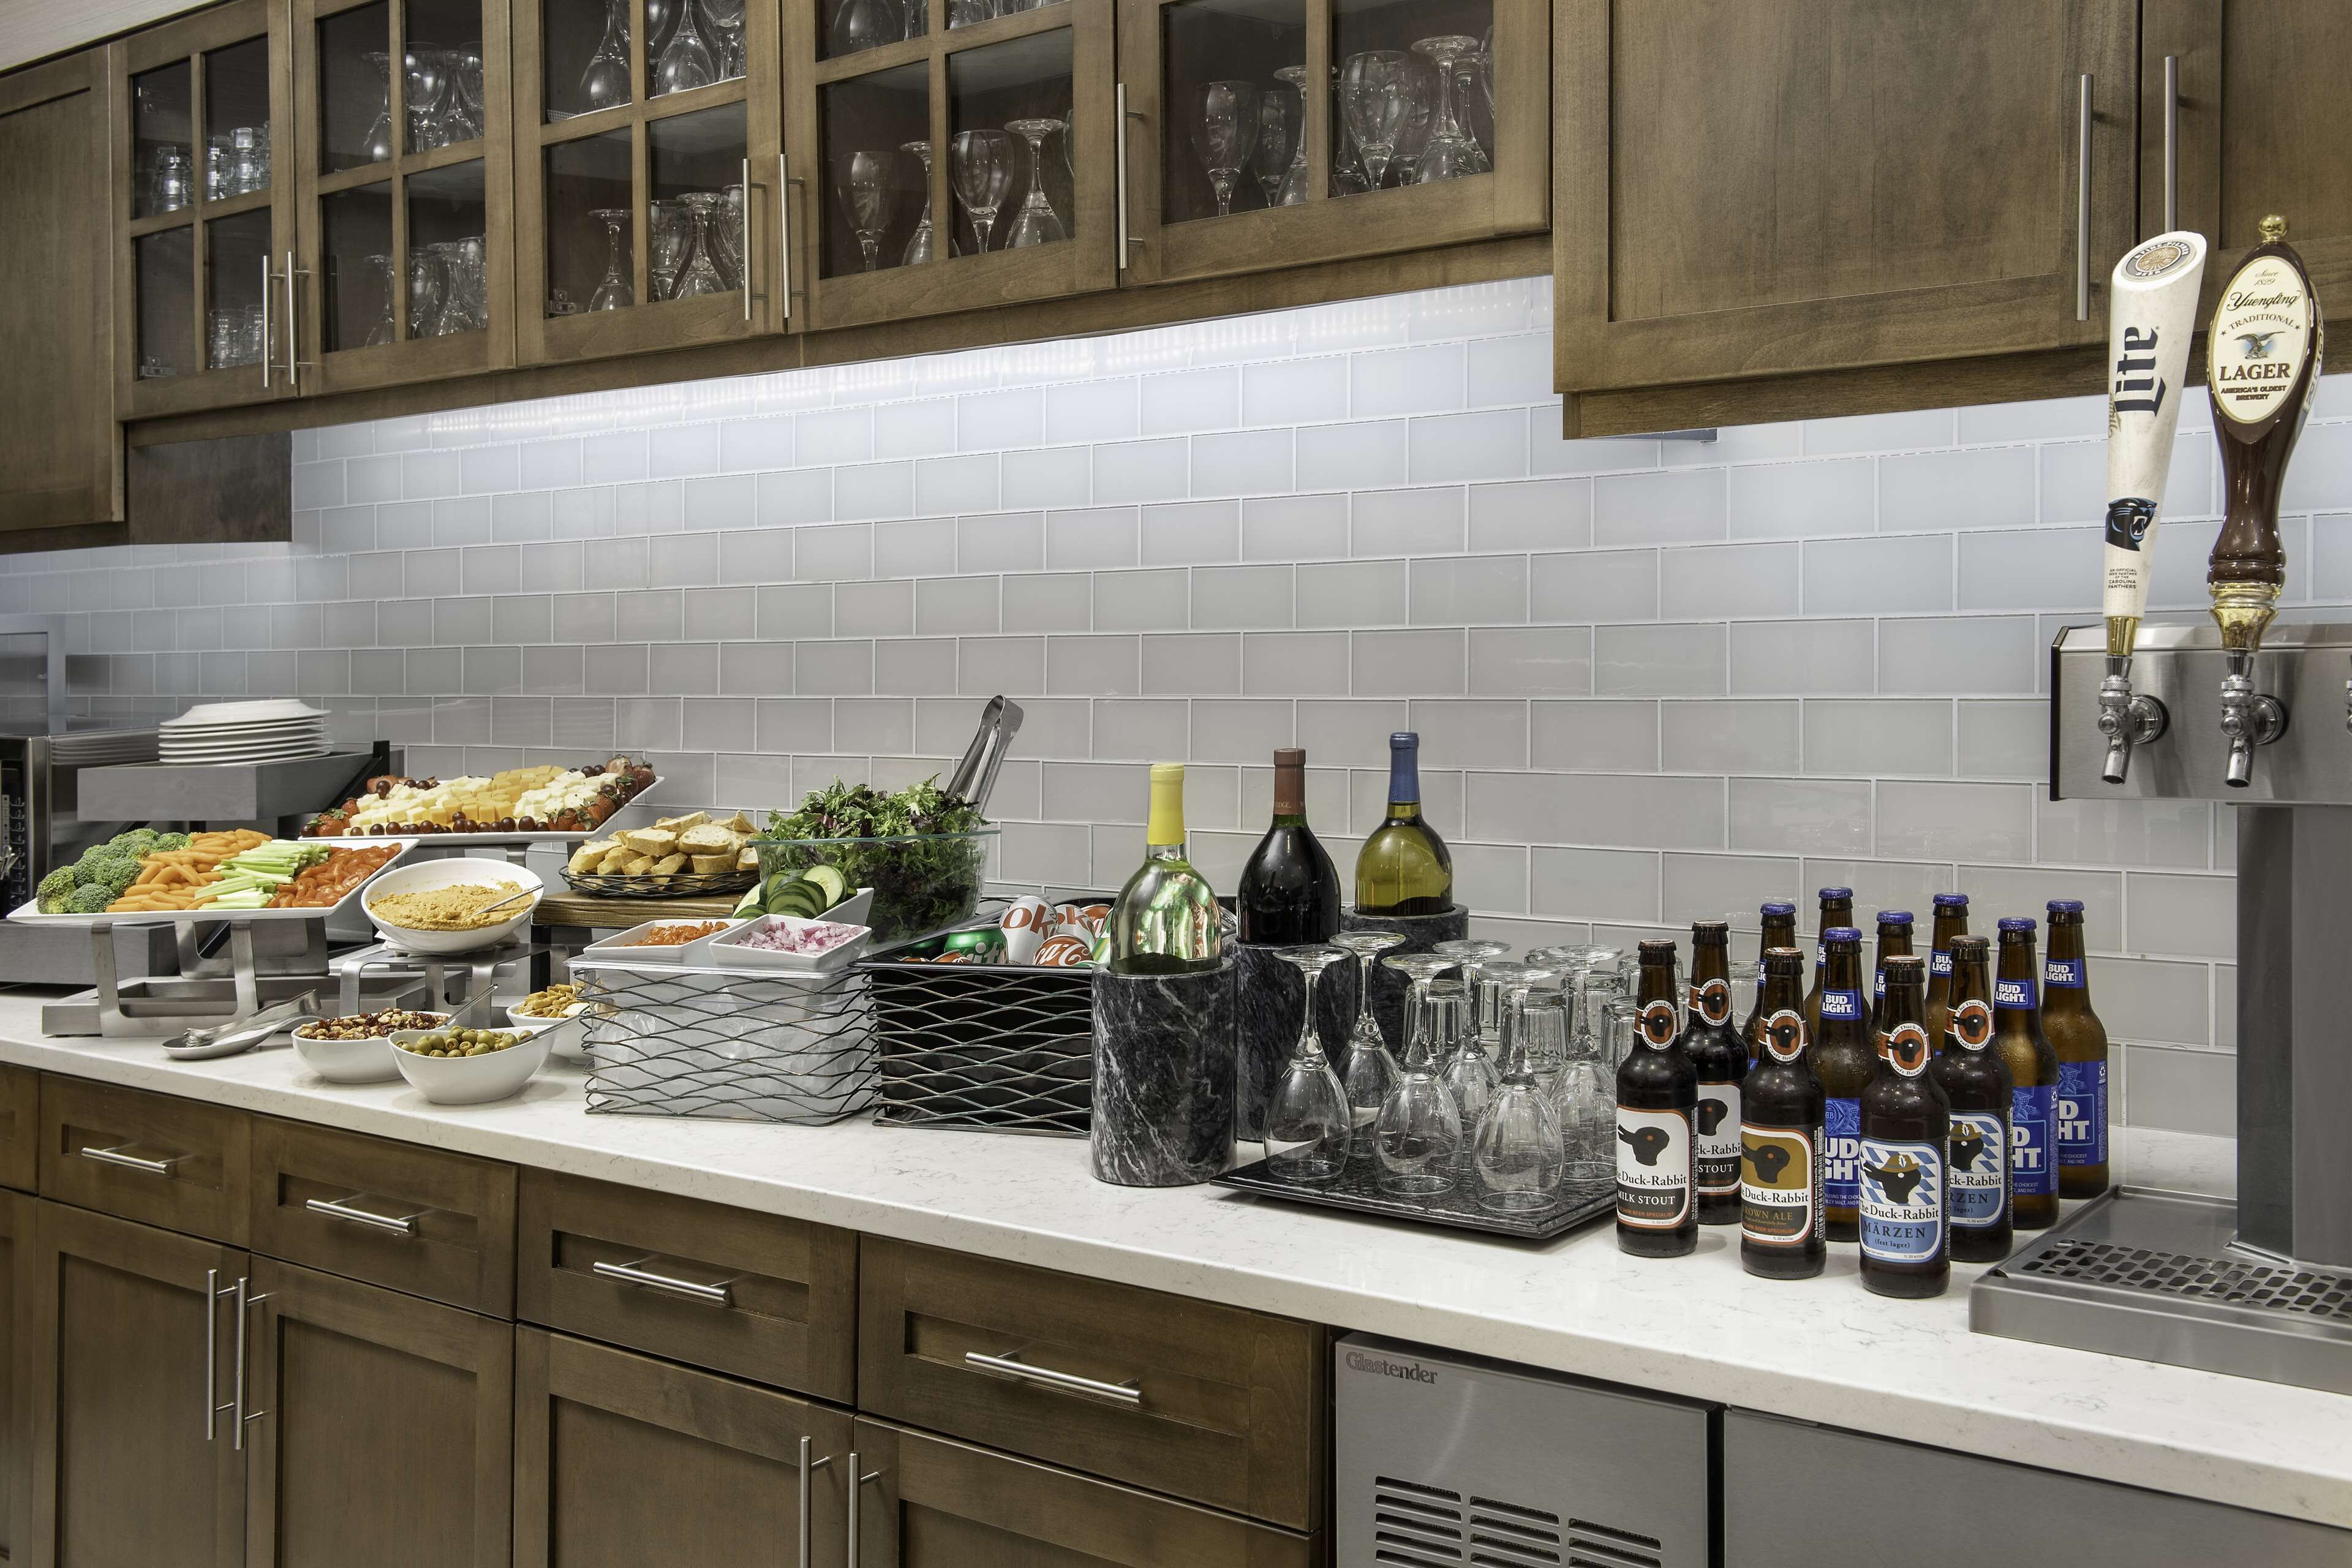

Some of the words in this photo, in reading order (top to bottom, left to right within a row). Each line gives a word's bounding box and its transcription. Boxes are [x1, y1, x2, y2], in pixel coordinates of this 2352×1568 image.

[2255, 269, 2279, 277] Since
[2226, 290, 2302, 311] Yuengling
[2228, 314, 2294, 331] TRADITIONAL
[2113, 326, 2166, 417] Lite
[2218, 363, 2291, 382] LAGER
[1932, 962, 1952, 972] LIGH
[2048, 963, 2069, 973] BUD
[1999, 983, 2021, 993] BUD
[1825, 994, 1848, 1005] BUD
[1825, 1138, 1860, 1158] UD
[1698, 1164, 1734, 1173] STOUT
[1622, 1170, 1686, 1186] Duck-Rabbit
[1618, 1189, 1635, 1203] MILK
[1638, 1195, 1675, 1205] STOUT
[1745, 1187, 1809, 1203] Duck-Rabbit
[1773, 1212, 1793, 1220] ALE
[1870, 1205, 1939, 1219] Duck-Rabbit
[1863, 1220, 1926, 1238] MÄRZEN
[1890, 1239, 1910, 1249] lager)
[1346, 1351, 1438, 1384] Glastender
